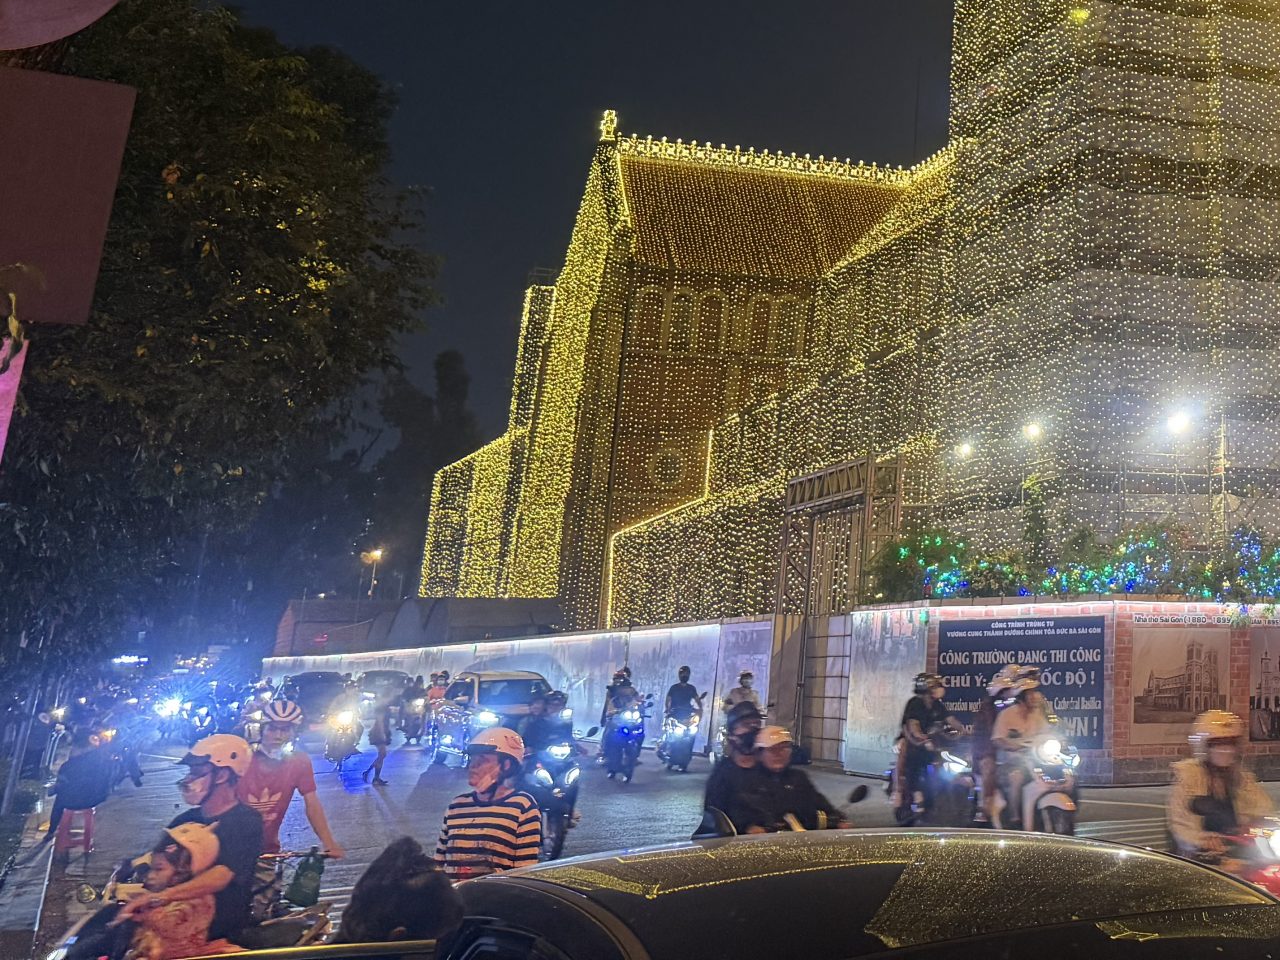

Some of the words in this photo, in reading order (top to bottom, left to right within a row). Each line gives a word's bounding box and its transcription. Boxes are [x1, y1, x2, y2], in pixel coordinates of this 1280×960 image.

[940, 650, 969, 665] CÔNG
[972, 648, 1015, 665] TRƯỜNG
[1017, 650, 1047, 664] ĐANG
[1050, 650, 1067, 663] THI
[1070, 647, 1101, 663] CÔNG
[942, 673, 970, 688] CHÚ
[1041, 667, 1062, 686] ỐC
[1065, 667, 1087, 689] ĐỘ
